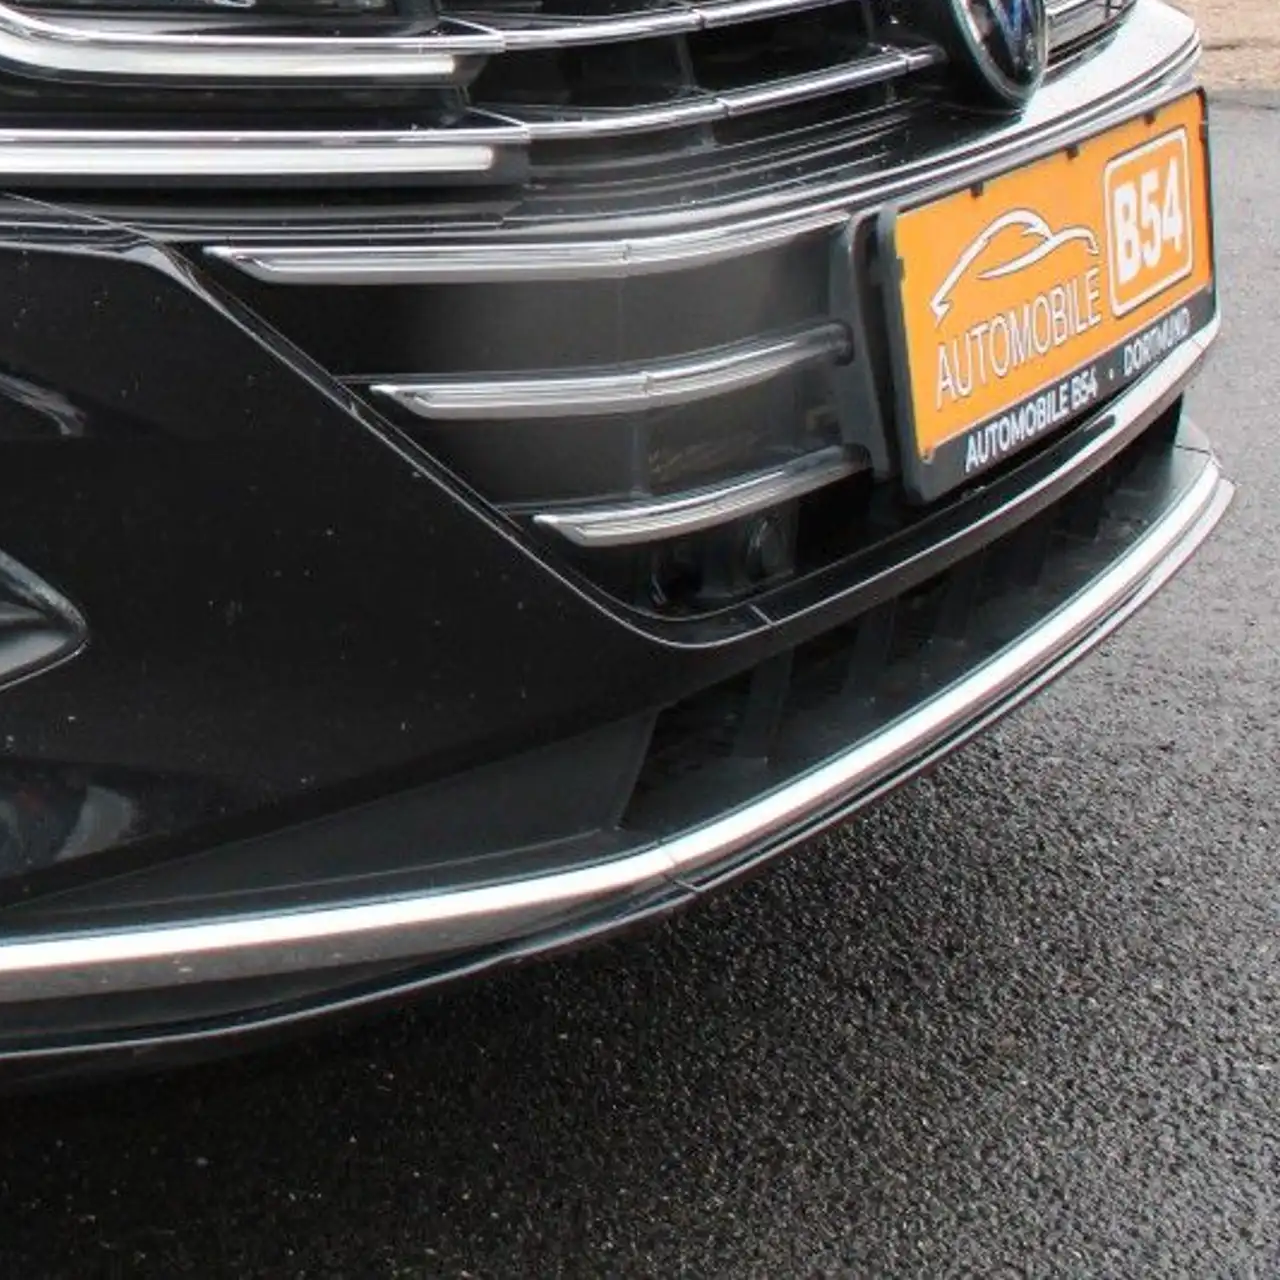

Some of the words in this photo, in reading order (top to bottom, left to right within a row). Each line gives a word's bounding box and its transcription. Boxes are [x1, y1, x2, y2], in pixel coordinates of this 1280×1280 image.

[1112, 155, 1184, 284] B54
[936, 267, 1102, 410] AUTOMOBILE
[965, 384, 1068, 473] AUTOMOBILE
[1071, 372, 1099, 411] B54
[1123, 307, 1192, 378] DORTMUND
